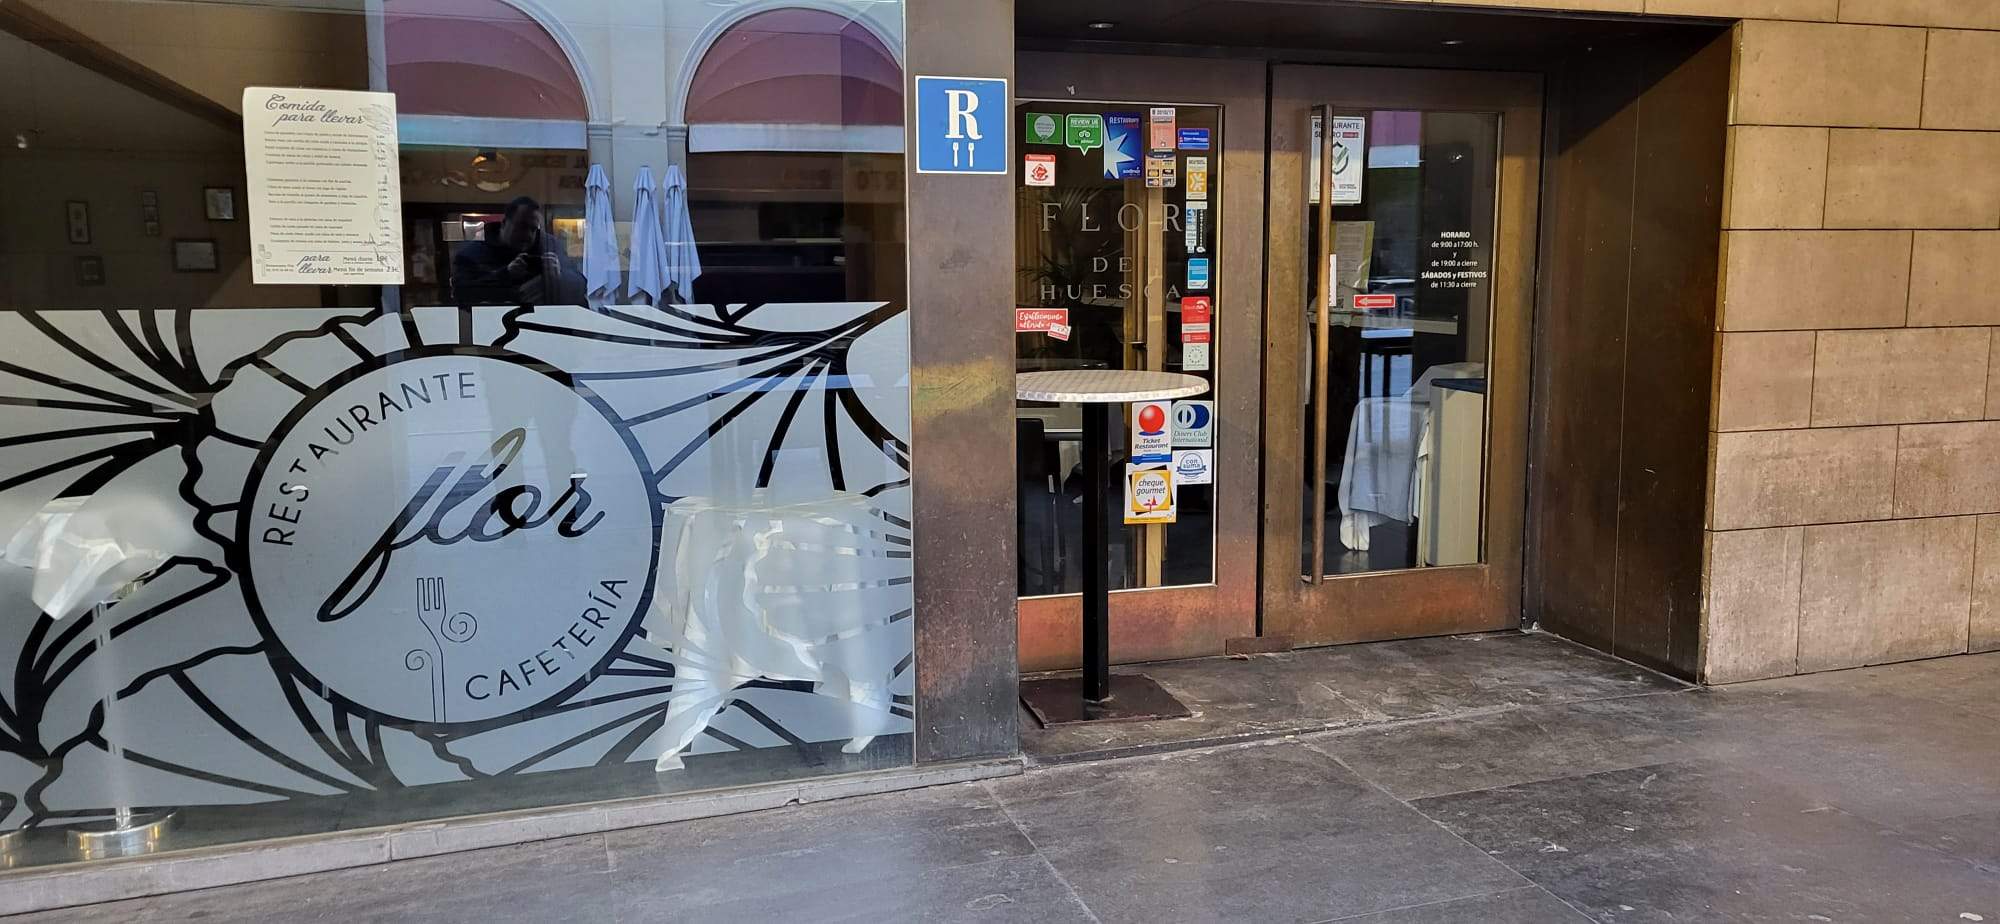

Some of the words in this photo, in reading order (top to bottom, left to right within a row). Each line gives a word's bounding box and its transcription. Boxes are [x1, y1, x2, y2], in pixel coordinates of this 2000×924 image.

[265, 93, 326, 111] Comida
[272, 112, 316, 127] para
[320, 109, 364, 124] llevar
[945, 89, 983, 140] R
[1314, 121, 1361, 130] RURANTE
[1041, 202, 1183, 232] FLOR
[1440, 231, 1471, 239] HORARIO
[1431, 240, 1440, 248] de
[297, 254, 331, 266] para
[1452, 251, 1458, 259] y
[298, 262, 333, 274] llevar
[1093, 256, 1133, 273] DE
[1431, 259, 1440, 267] de
[1461, 259, 1478, 267] cierre
[1421, 270, 1452, 279] SÁBADOS
[1452, 272, 1457, 280] y
[1457, 271, 1488, 279] FESTIVOS
[1173, 430, 1193, 438] Diners
[1135, 442, 1169, 450] Restaurant
[262, 371, 477, 546] RESTAURANTE
[1138, 479, 1164, 488] cheque
[1135, 486, 1166, 497] gourmet
[316, 427, 605, 622] flor
[465, 575, 628, 701] CAFETERÍA
